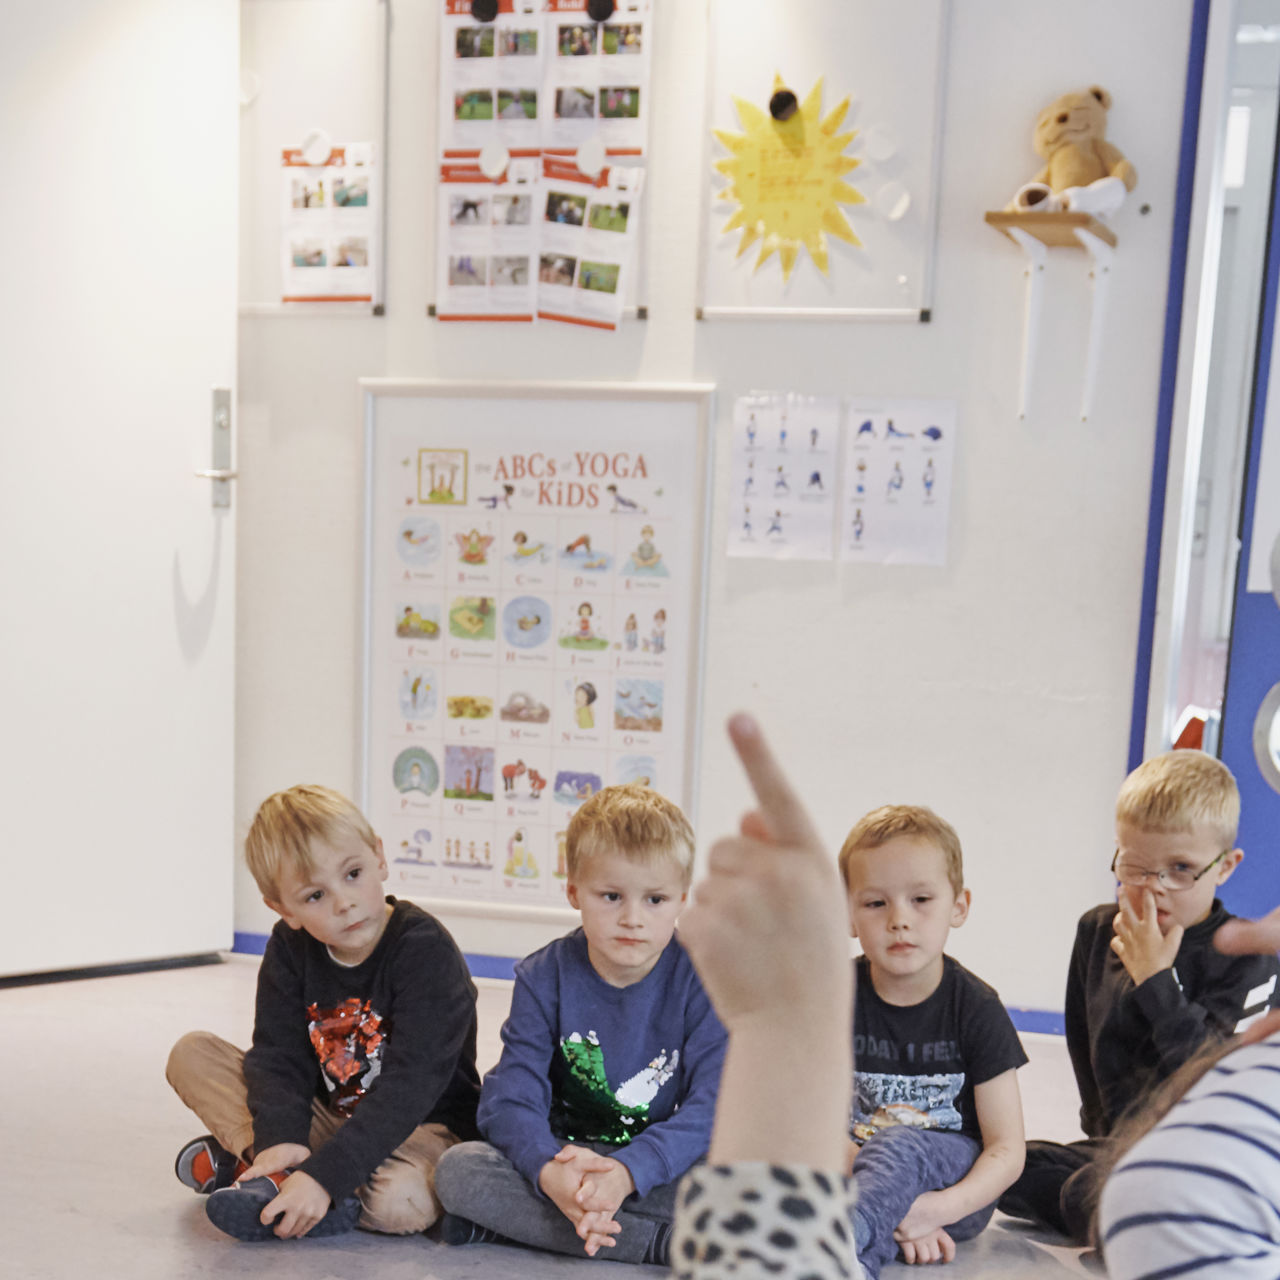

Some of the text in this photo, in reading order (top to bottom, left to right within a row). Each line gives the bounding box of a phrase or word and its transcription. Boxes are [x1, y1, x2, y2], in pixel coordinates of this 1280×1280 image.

[493, 453, 558, 481] ABCs
[574, 452, 649, 479] YOGA
[854, 1034, 900, 1061] ODAY
